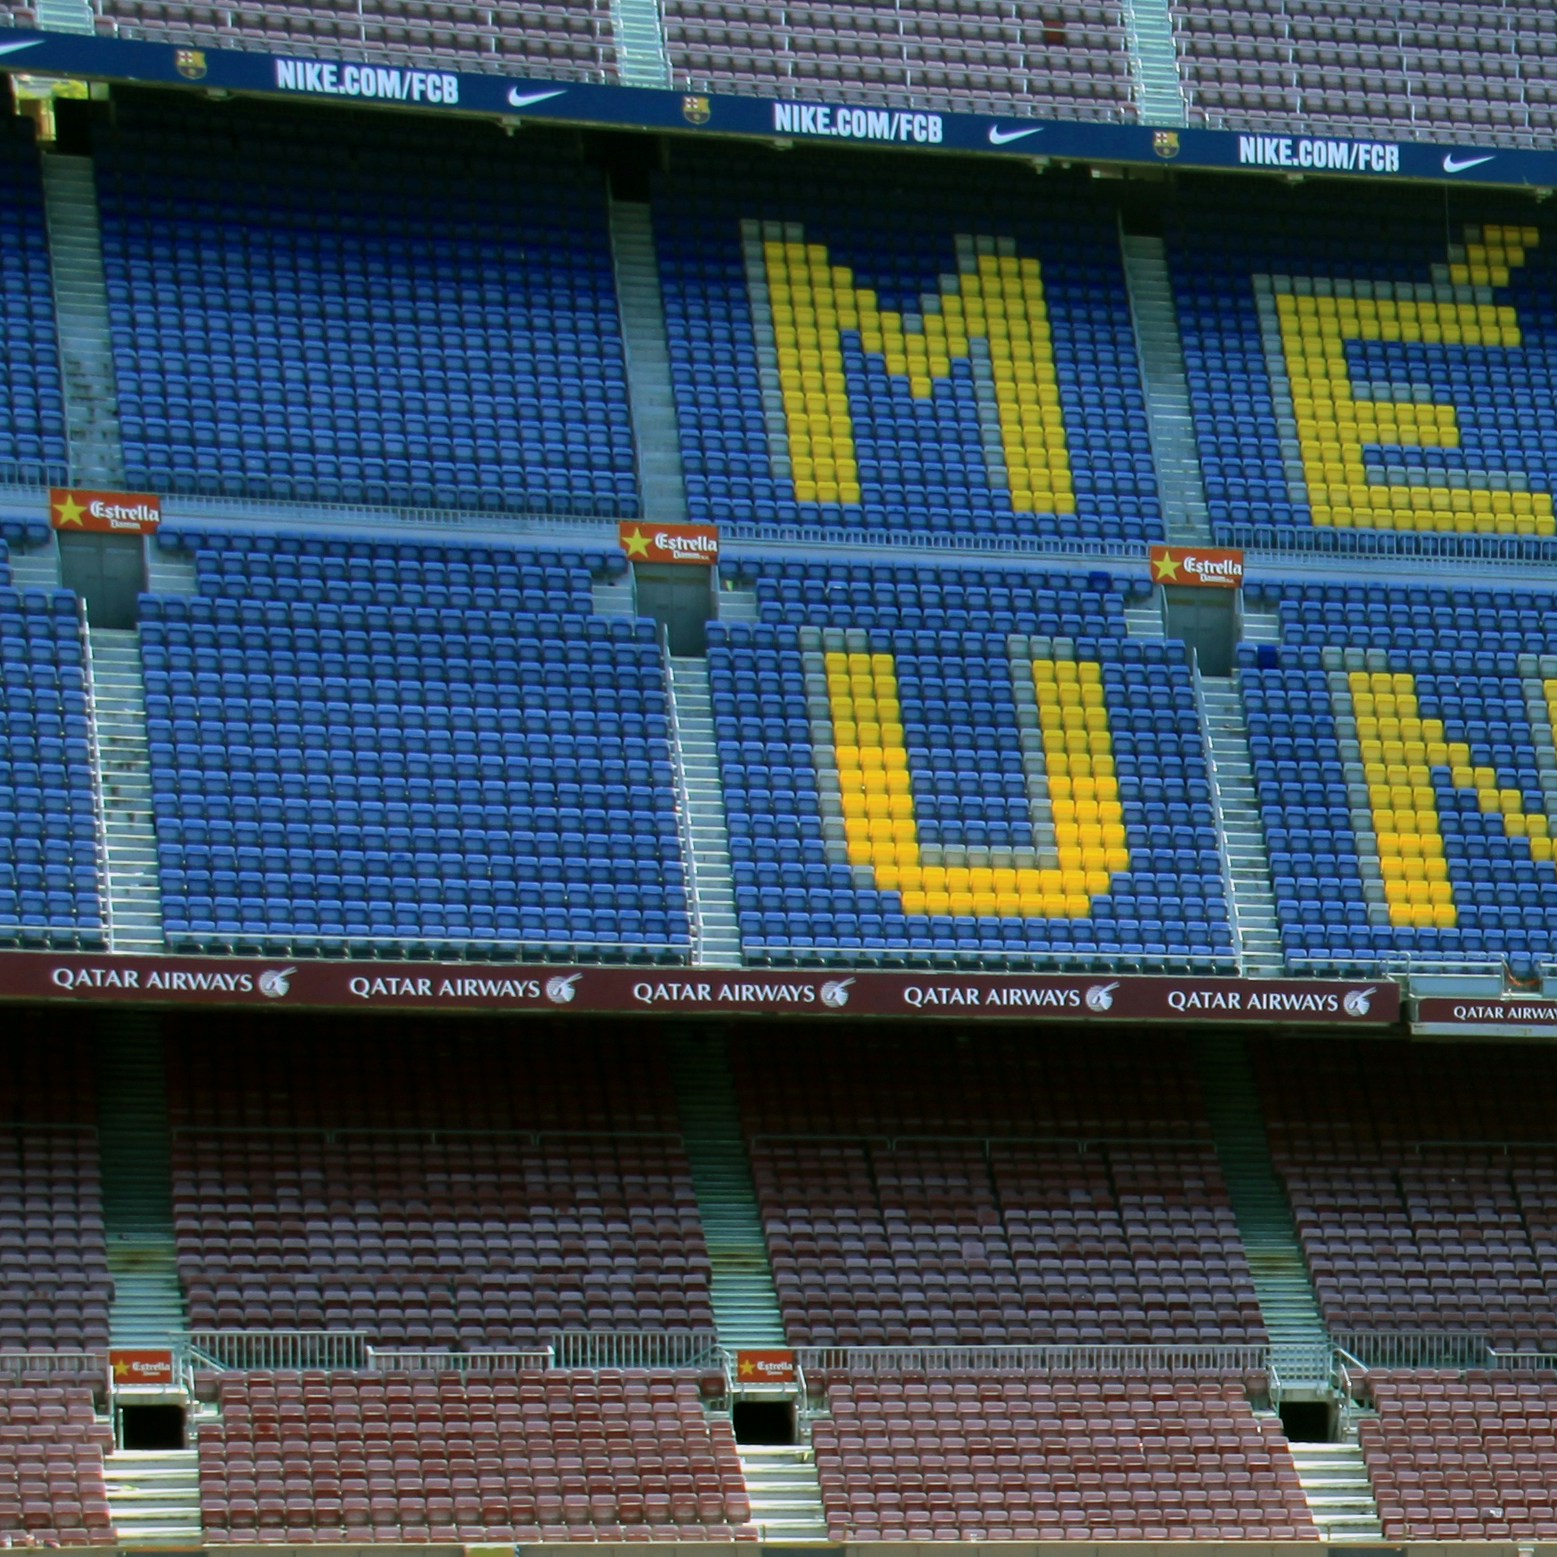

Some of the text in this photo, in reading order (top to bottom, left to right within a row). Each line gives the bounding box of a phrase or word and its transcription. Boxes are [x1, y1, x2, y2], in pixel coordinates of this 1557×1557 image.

[276, 57, 459, 104] NIKE.COM/FCB
[774, 103, 943, 144] NIKE.COM/FCB
[1239, 136, 1399, 172] NIKE.COM/FCB
[91, 500, 160, 522] Estrella
[655, 532, 718, 552] Estrella
[1183, 556, 1242, 575] Estrella
[51, 968, 254, 992] QATAR AIRWAYS
[349, 977, 541, 998] QATAR AIRWAYS
[632, 983, 816, 1004] QATAR AIRWAYS
[903, 987, 1081, 1007] QATAR AIRWAYS
[1167, 991, 1339, 1011] QATAR AIRWAYS
[1453, 1006, 1505, 1020] QATAR
